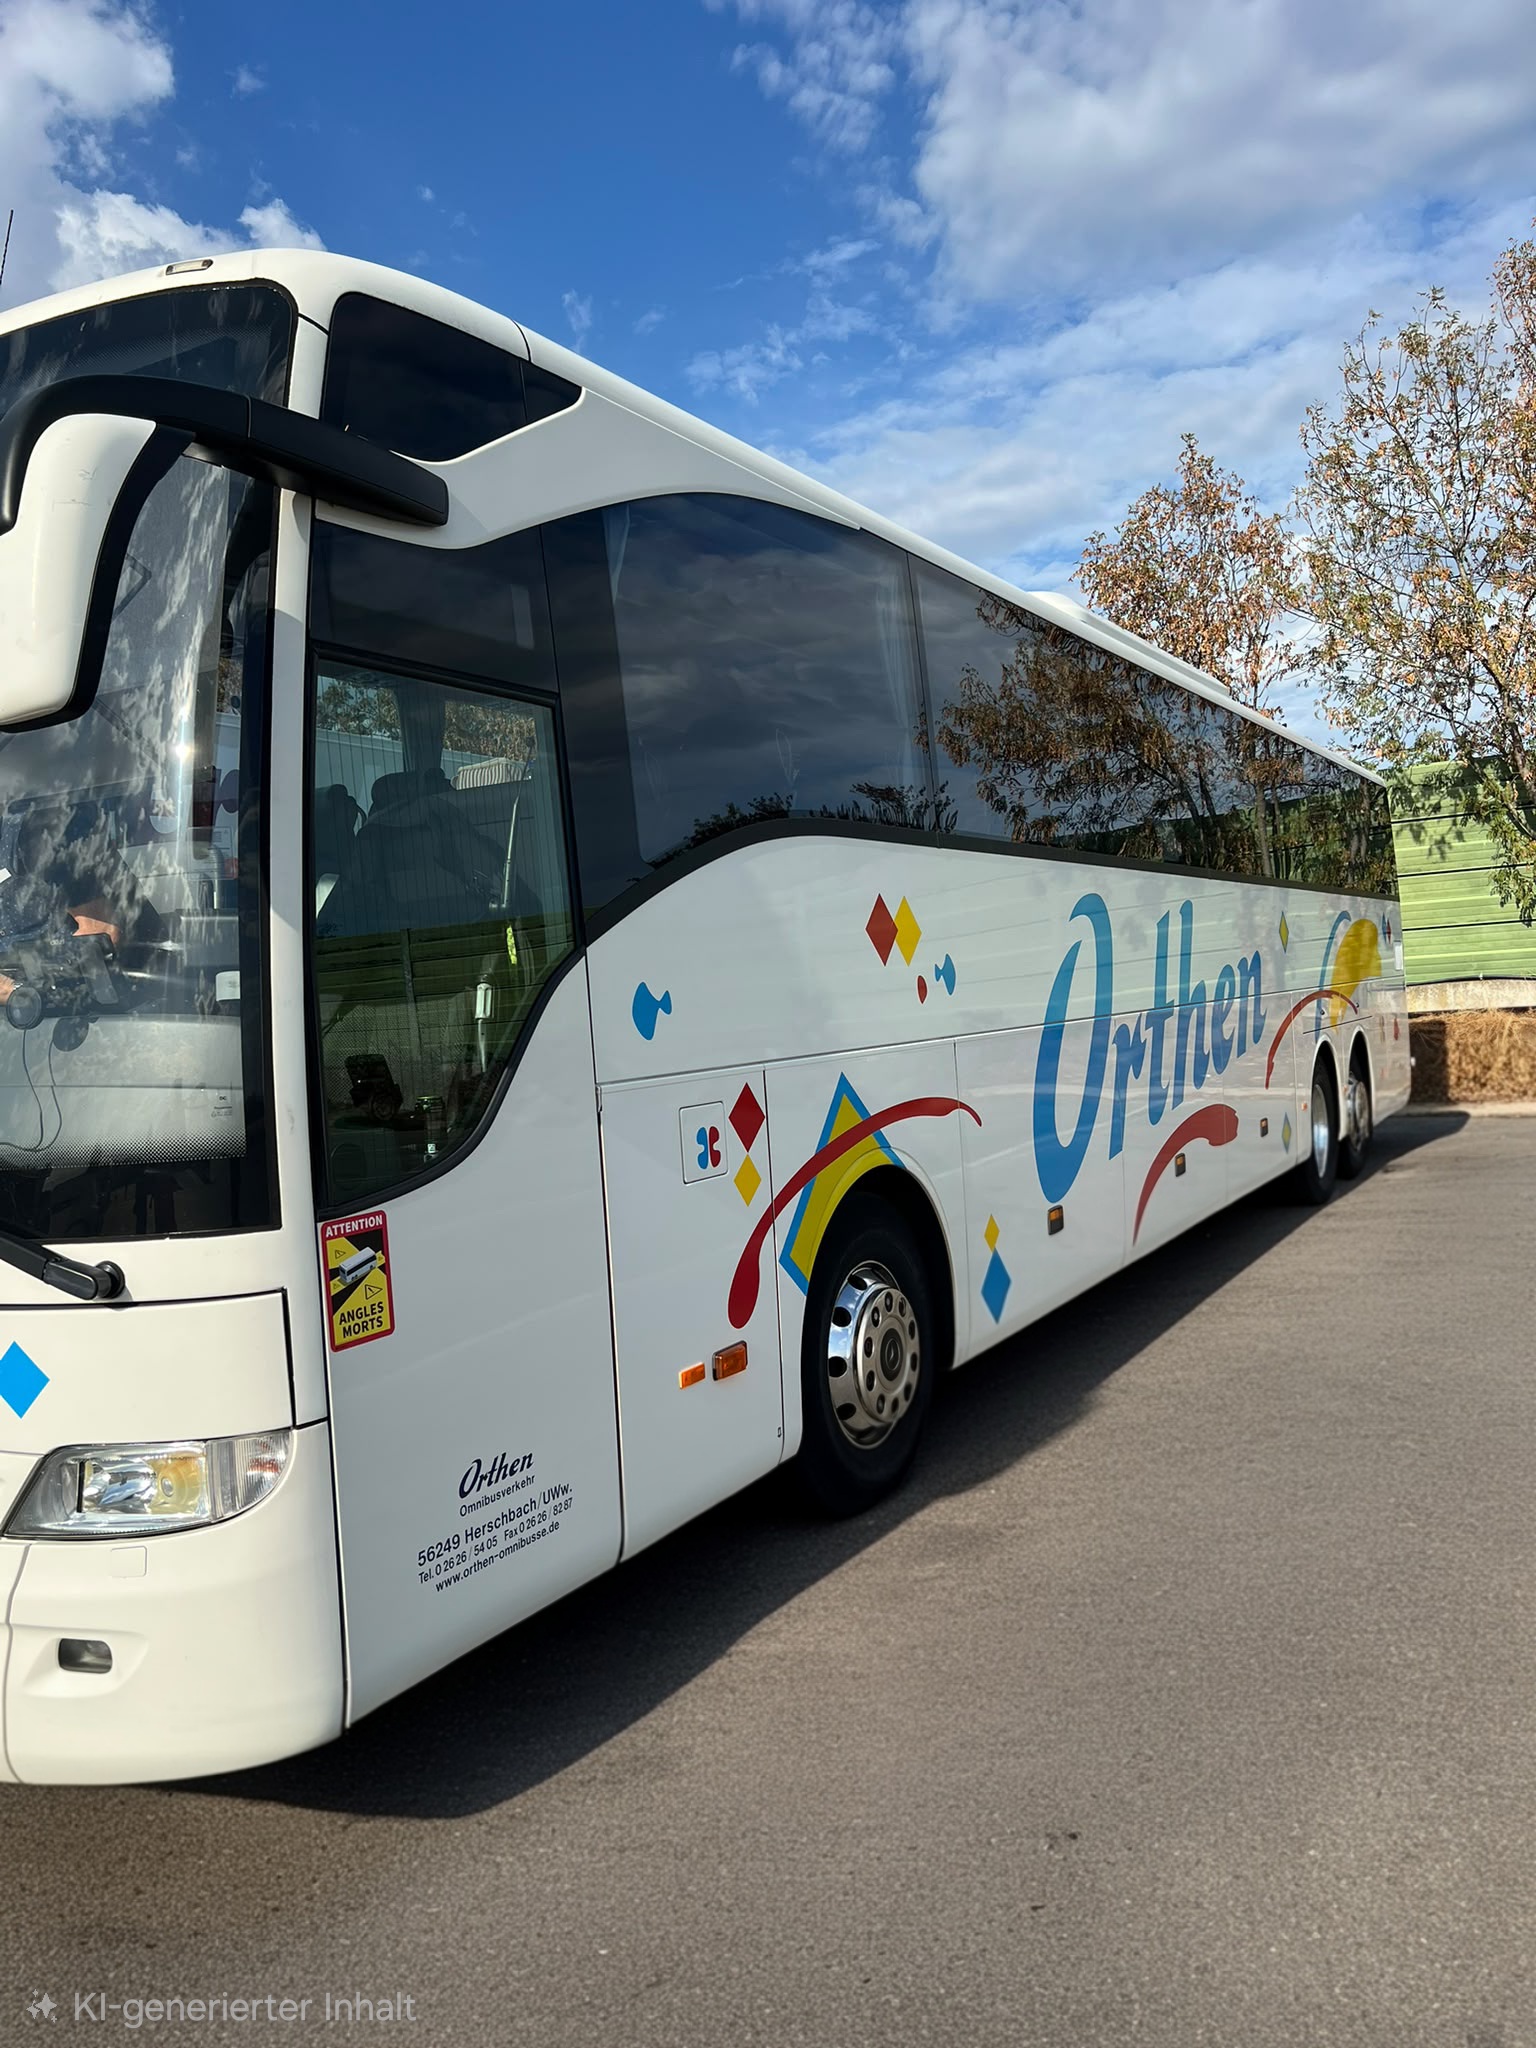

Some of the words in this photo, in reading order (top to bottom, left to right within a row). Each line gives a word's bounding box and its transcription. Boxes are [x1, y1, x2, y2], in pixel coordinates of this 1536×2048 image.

[1033, 893, 1268, 1204] Orthen
[325, 1215, 383, 1238] ATTENTION
[339, 1301, 384, 1325] ANGLES
[342, 1316, 383, 1339] MORTS
[458, 1452, 534, 1499] Orthen
[459, 1475, 535, 1517] Omnibusverkehr
[418, 1534, 461, 1567] 56249
[435, 1520, 560, 1592] www.orthen-omnibusse.de
[418, 1568, 435, 1584] Tel.
